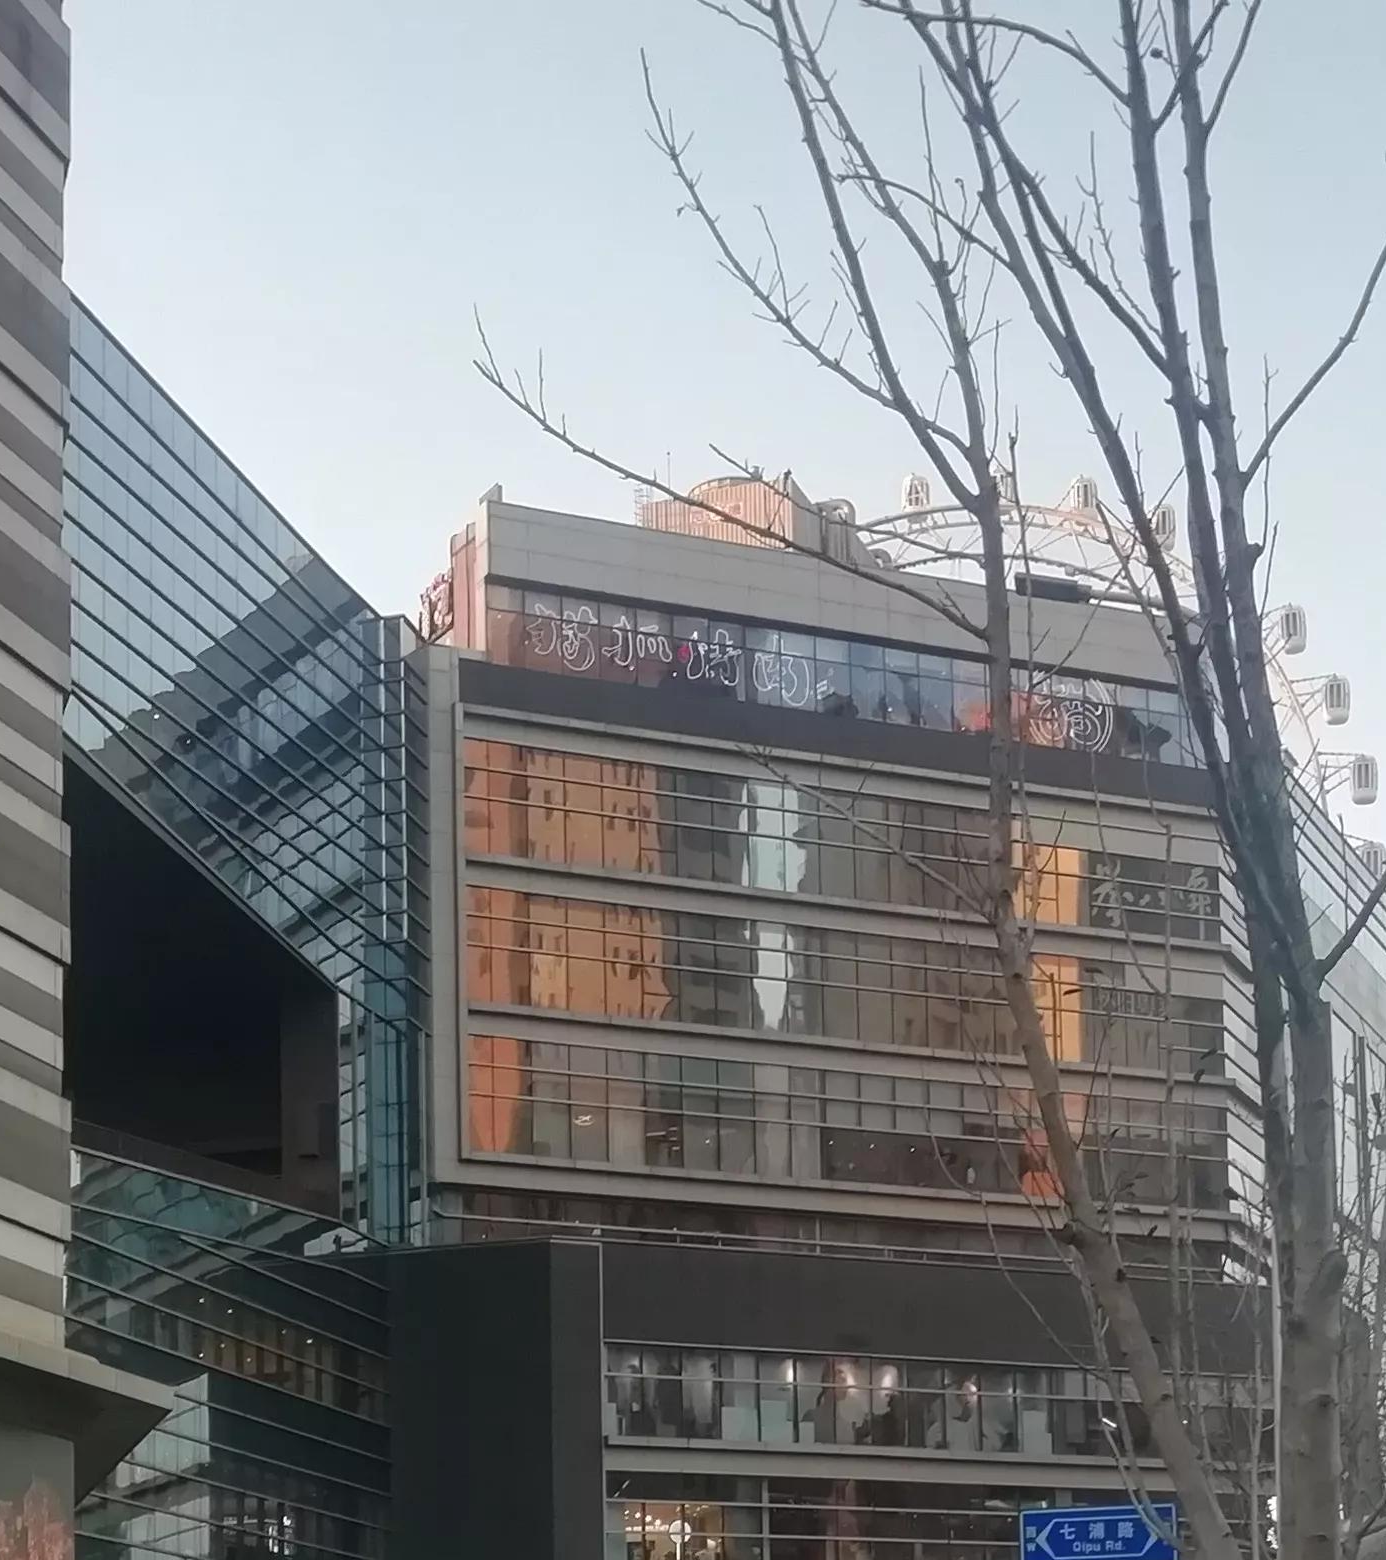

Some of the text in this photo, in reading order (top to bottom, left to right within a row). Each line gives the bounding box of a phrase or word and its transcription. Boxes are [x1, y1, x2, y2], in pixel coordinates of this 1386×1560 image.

[1059, 1522, 1134, 1540] 七浦路
[1026, 1543, 1036, 1552] W
[1073, 1540, 1126, 1554] Qipu Rd.
